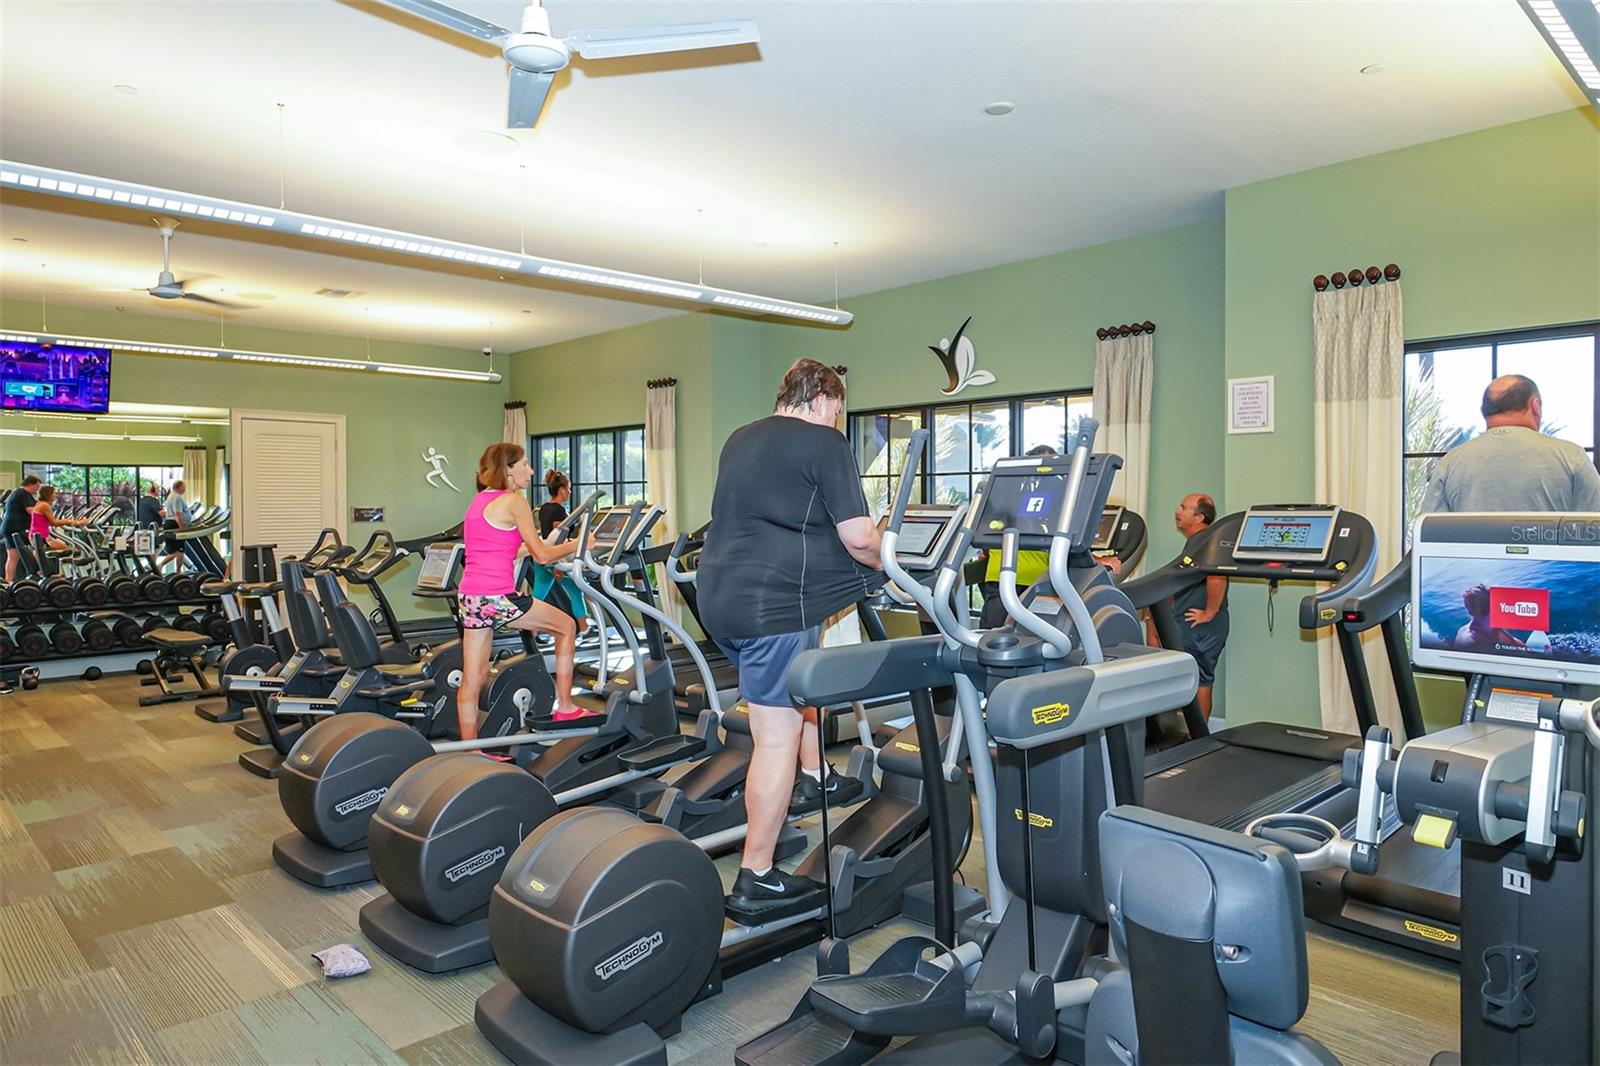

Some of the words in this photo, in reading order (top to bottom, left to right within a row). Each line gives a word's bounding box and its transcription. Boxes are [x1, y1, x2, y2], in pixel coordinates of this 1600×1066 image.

[1500, 603, 1537, 615] YouTube
[446, 847, 503, 880] TECHNOGYM
[596, 934, 661, 977] TECHNOGYM
